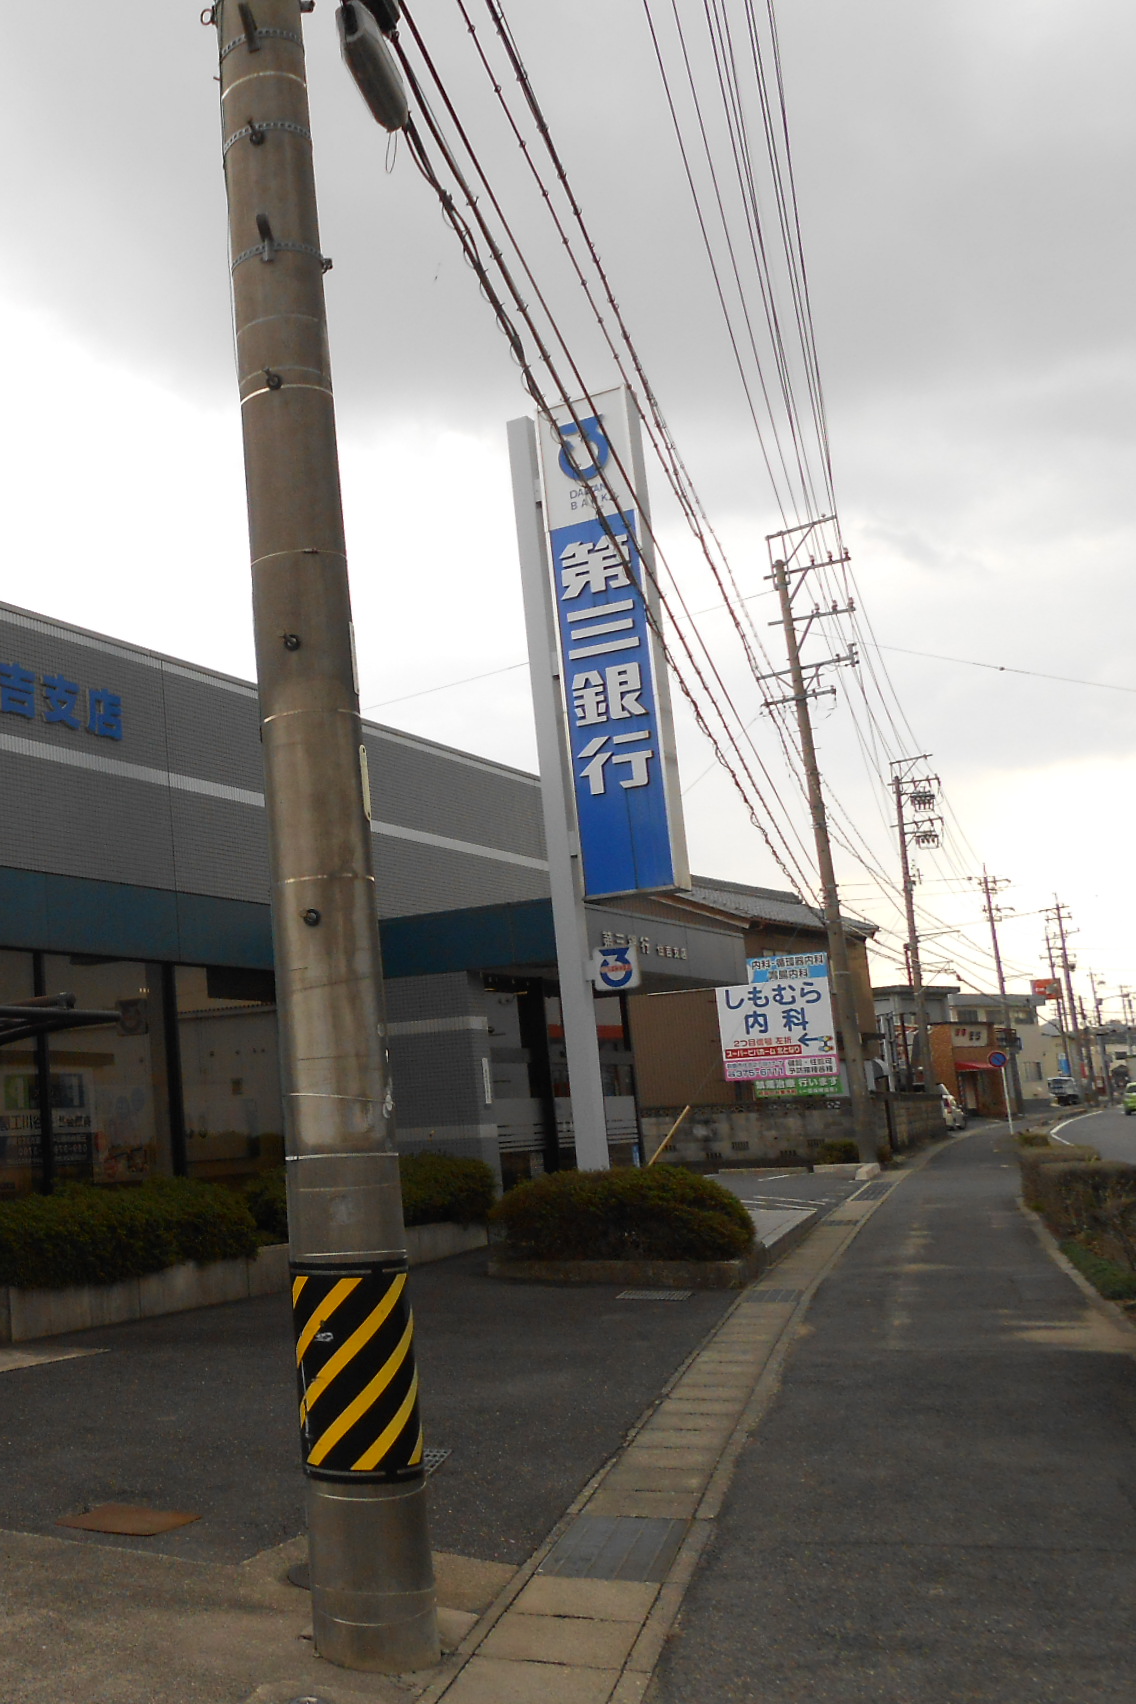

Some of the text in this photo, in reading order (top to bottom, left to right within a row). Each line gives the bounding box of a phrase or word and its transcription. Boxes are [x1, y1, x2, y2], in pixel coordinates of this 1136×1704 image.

[560, 533, 653, 796] 第三銀行
[725, 982, 822, 1010] しもむら
[744, 1007, 809, 1035] 内科
